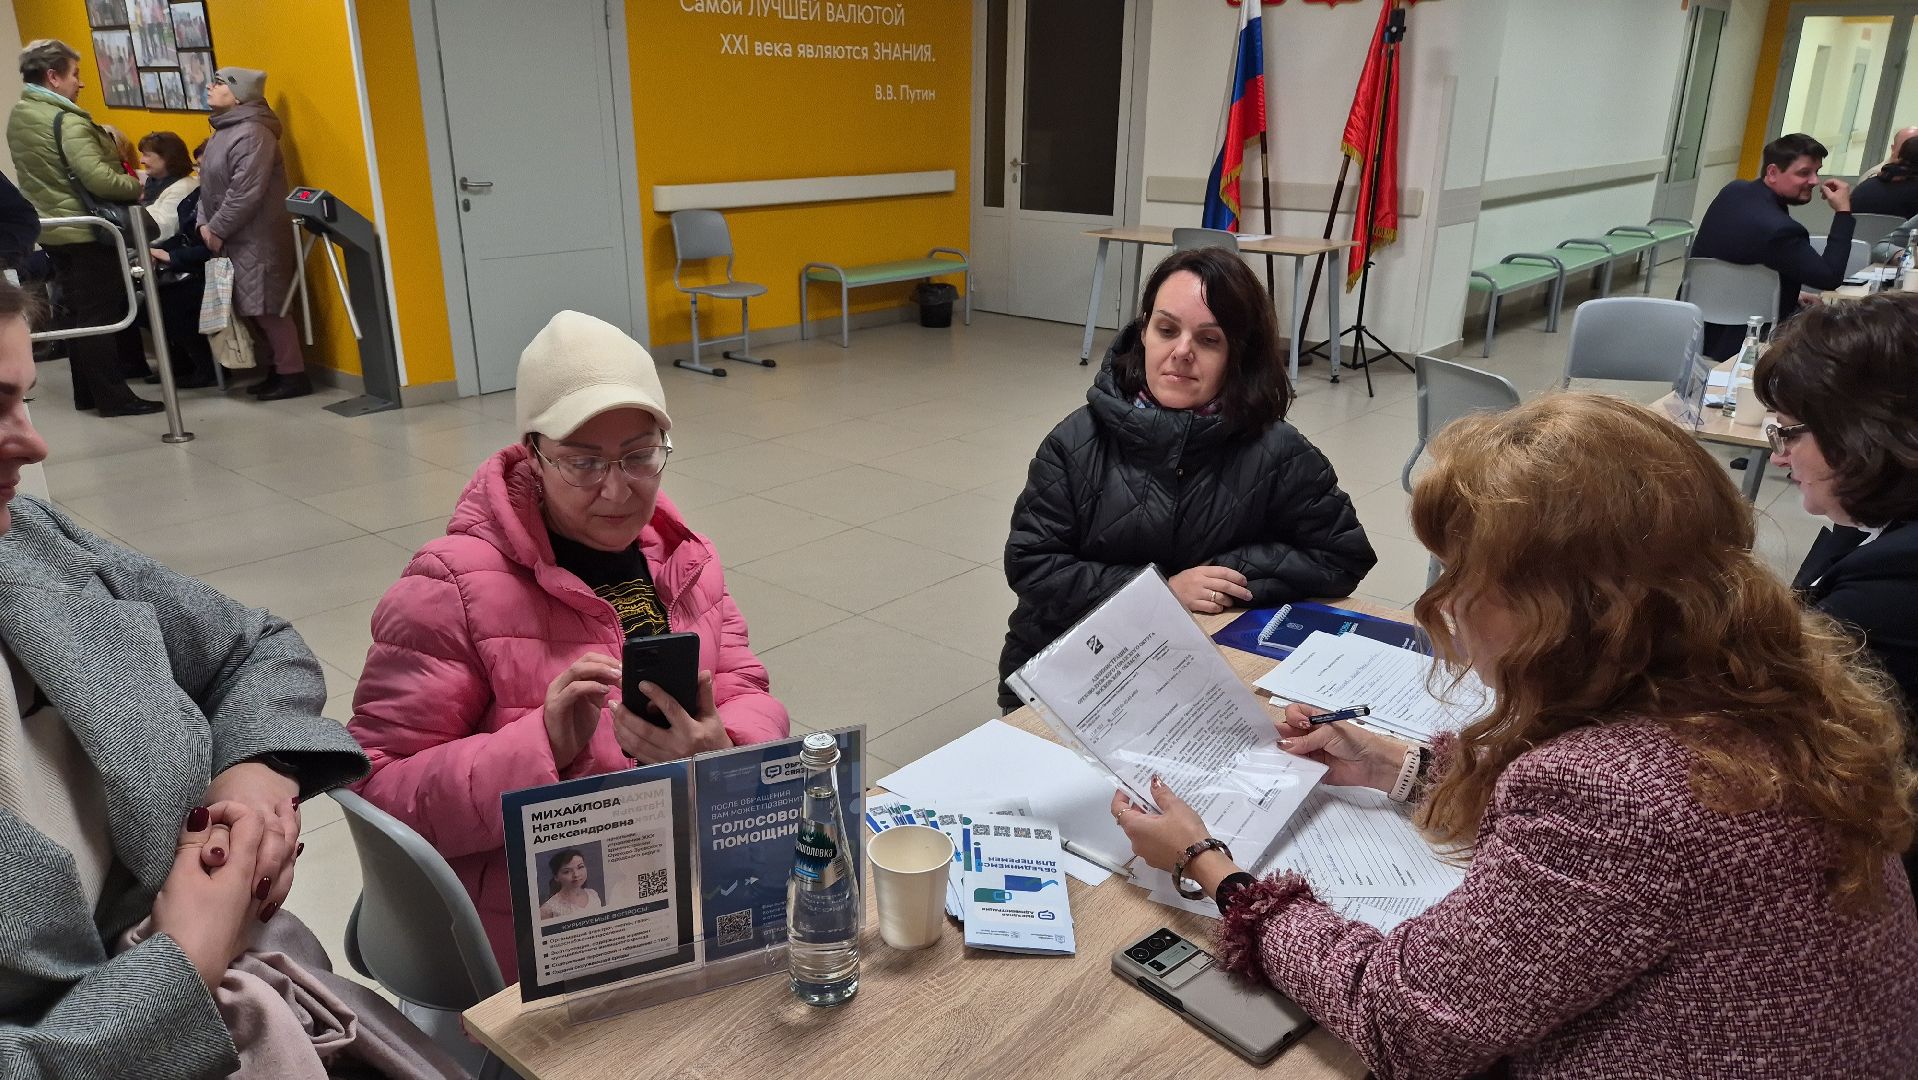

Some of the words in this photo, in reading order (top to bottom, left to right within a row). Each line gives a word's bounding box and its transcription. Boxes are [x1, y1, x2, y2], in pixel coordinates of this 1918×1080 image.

[680, 0, 742, 16] Самой
[748, 0, 821, 22] ЛУЧШЕЙ
[826, 2, 905, 26] ВАЛЮТОЙ
[755, 41, 792, 57] века
[797, 43, 868, 60] являются
[873, 42, 936, 62] ЗНАНИЯ.
[875, 85, 897, 101] В.В.
[900, 85, 936, 104] Путин
[531, 797, 621, 822] МИХАЙЛОВА
[711, 800, 738, 811] ПОСЛЕ
[740, 789, 791, 805] ОБРАЩЕНИЯ
[711, 811, 729, 820] ВАМ
[731, 805, 759, 817] МОЖЕТ
[712, 808, 802, 835] ГОЛОСОВО
[532, 816, 587, 833] Наталья
[533, 819, 634, 845] Александровна
[713, 823, 799, 850] ПОМОЩНИ
[987, 856, 1034, 865] ПЕРЕМЕН
[1034, 860, 1056, 868] ДЛЯ
